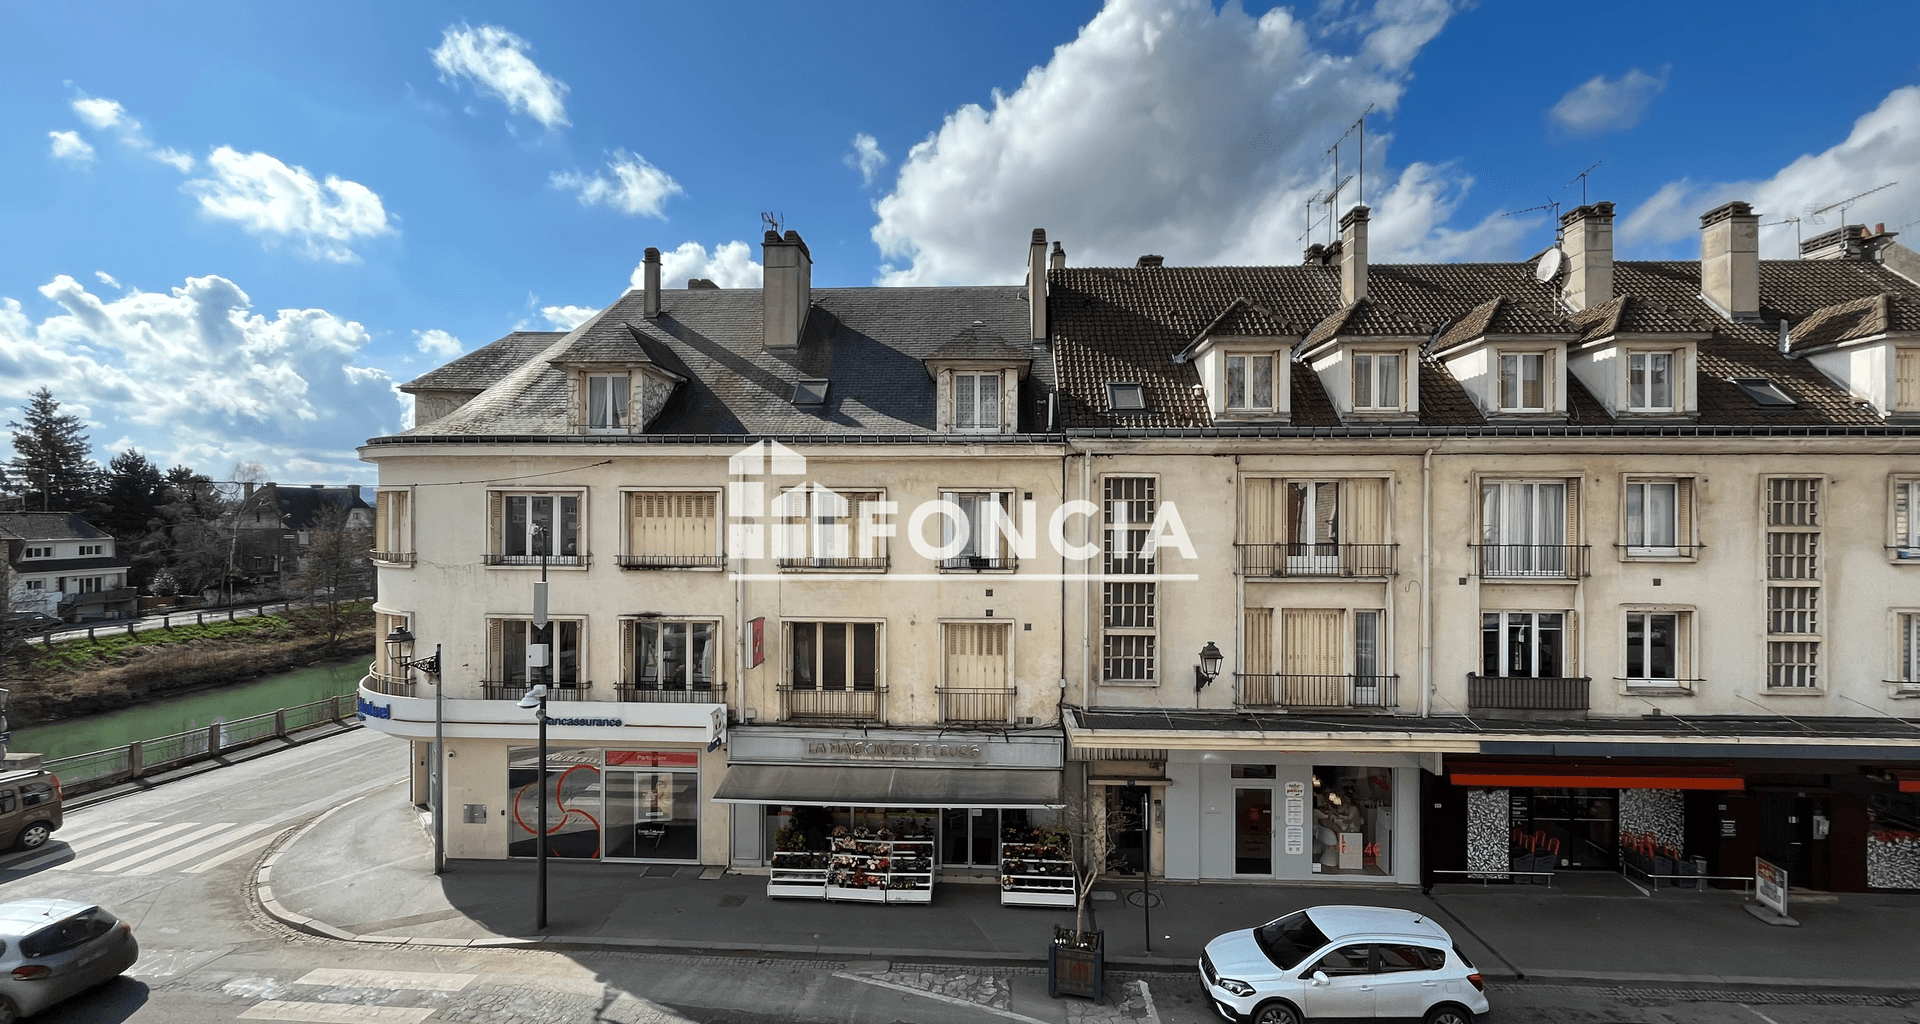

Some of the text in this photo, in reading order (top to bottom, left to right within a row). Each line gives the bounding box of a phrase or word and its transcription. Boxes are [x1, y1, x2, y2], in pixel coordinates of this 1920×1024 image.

[547, 717, 623, 727] ancassurance
[808, 741, 980, 758] LA MAISON DES FLEURS
